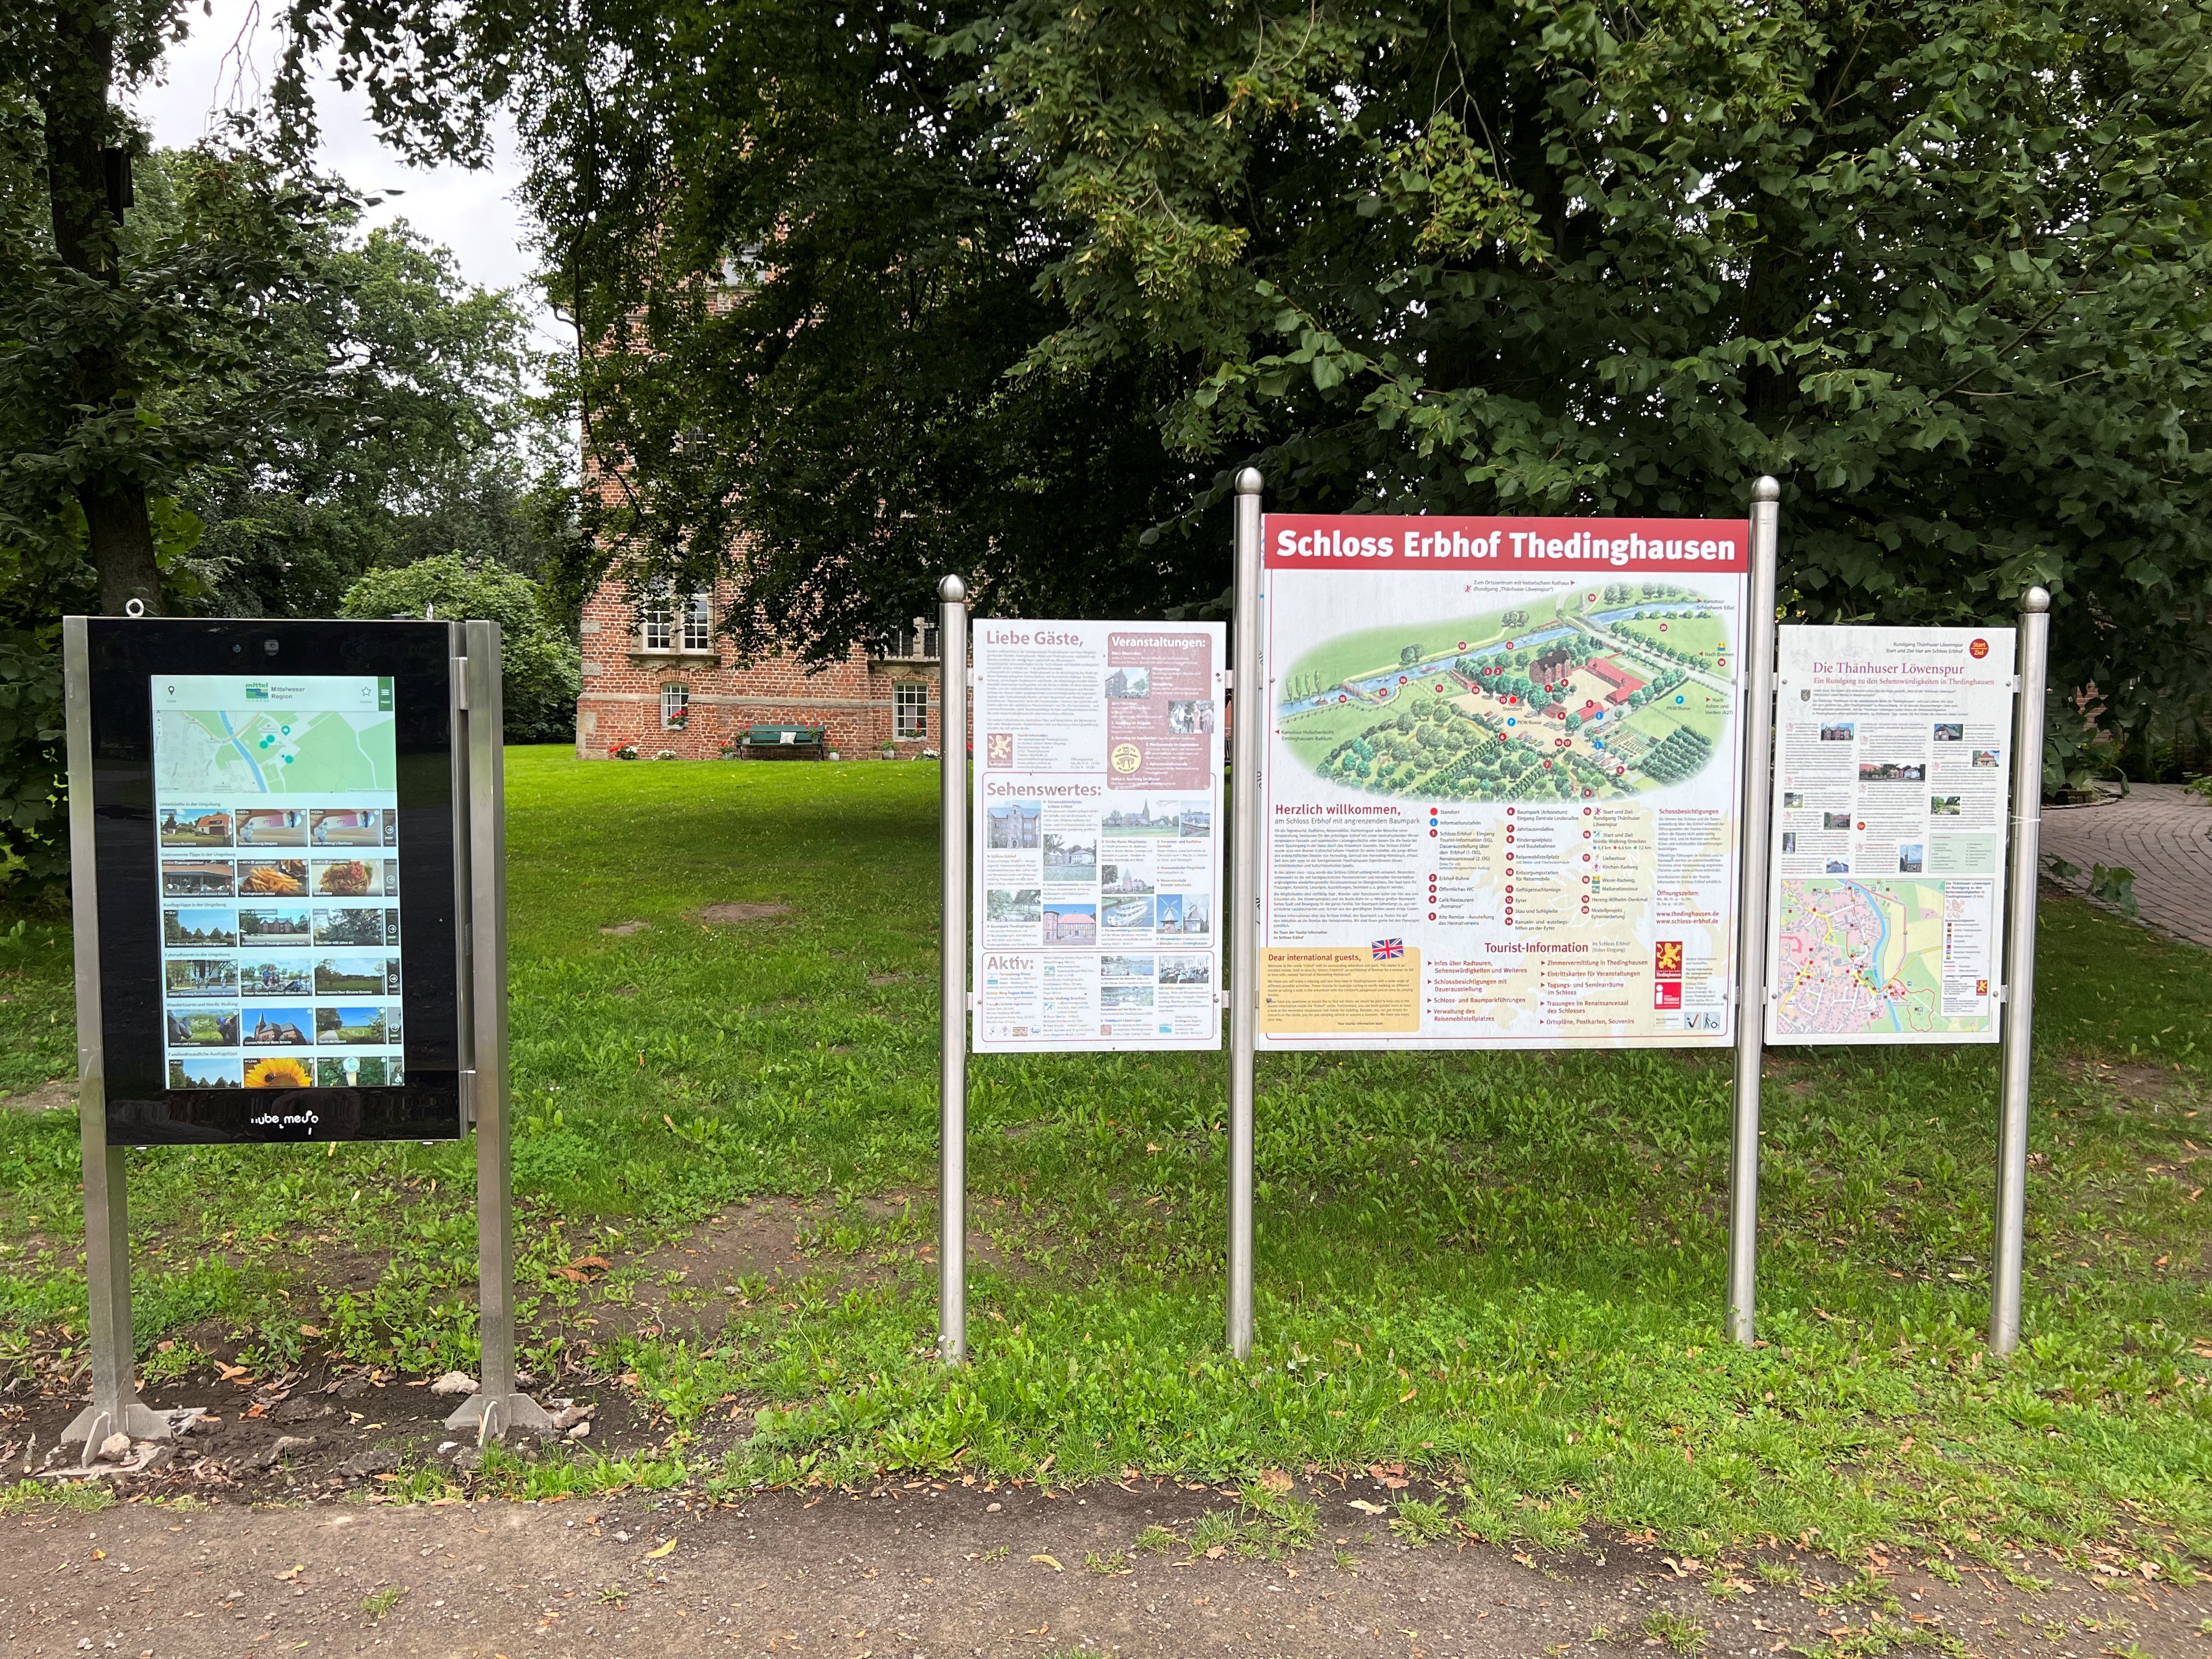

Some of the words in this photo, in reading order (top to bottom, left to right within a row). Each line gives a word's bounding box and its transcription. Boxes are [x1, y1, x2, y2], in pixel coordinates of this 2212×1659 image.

[1276, 530, 1393, 558] Schloss
[1404, 531, 1502, 558] Erbhof
[1509, 532, 1735, 565] Thedinghausen
[987, 631, 1029, 645] Liebe
[1035, 631, 1083, 647] Gäste,
[1111, 636, 1205, 647] Veranstaltungen:
[1814, 662, 1833, 674] Die
[1837, 663, 1898, 674] Thänhuser
[1903, 663, 1965, 676] Löwenspur
[1826, 678, 1857, 686] Rundgang
[1949, 678, 1994, 686] Thedinghausen
[988, 782, 1101, 795] Sehenswertes:
[1276, 804, 1322, 815] Herzlich
[1326, 804, 1401, 816] willkommen,
[1485, 943, 1588, 952] Tourist-Information
[988, 956, 1034, 969] Aktiv:
